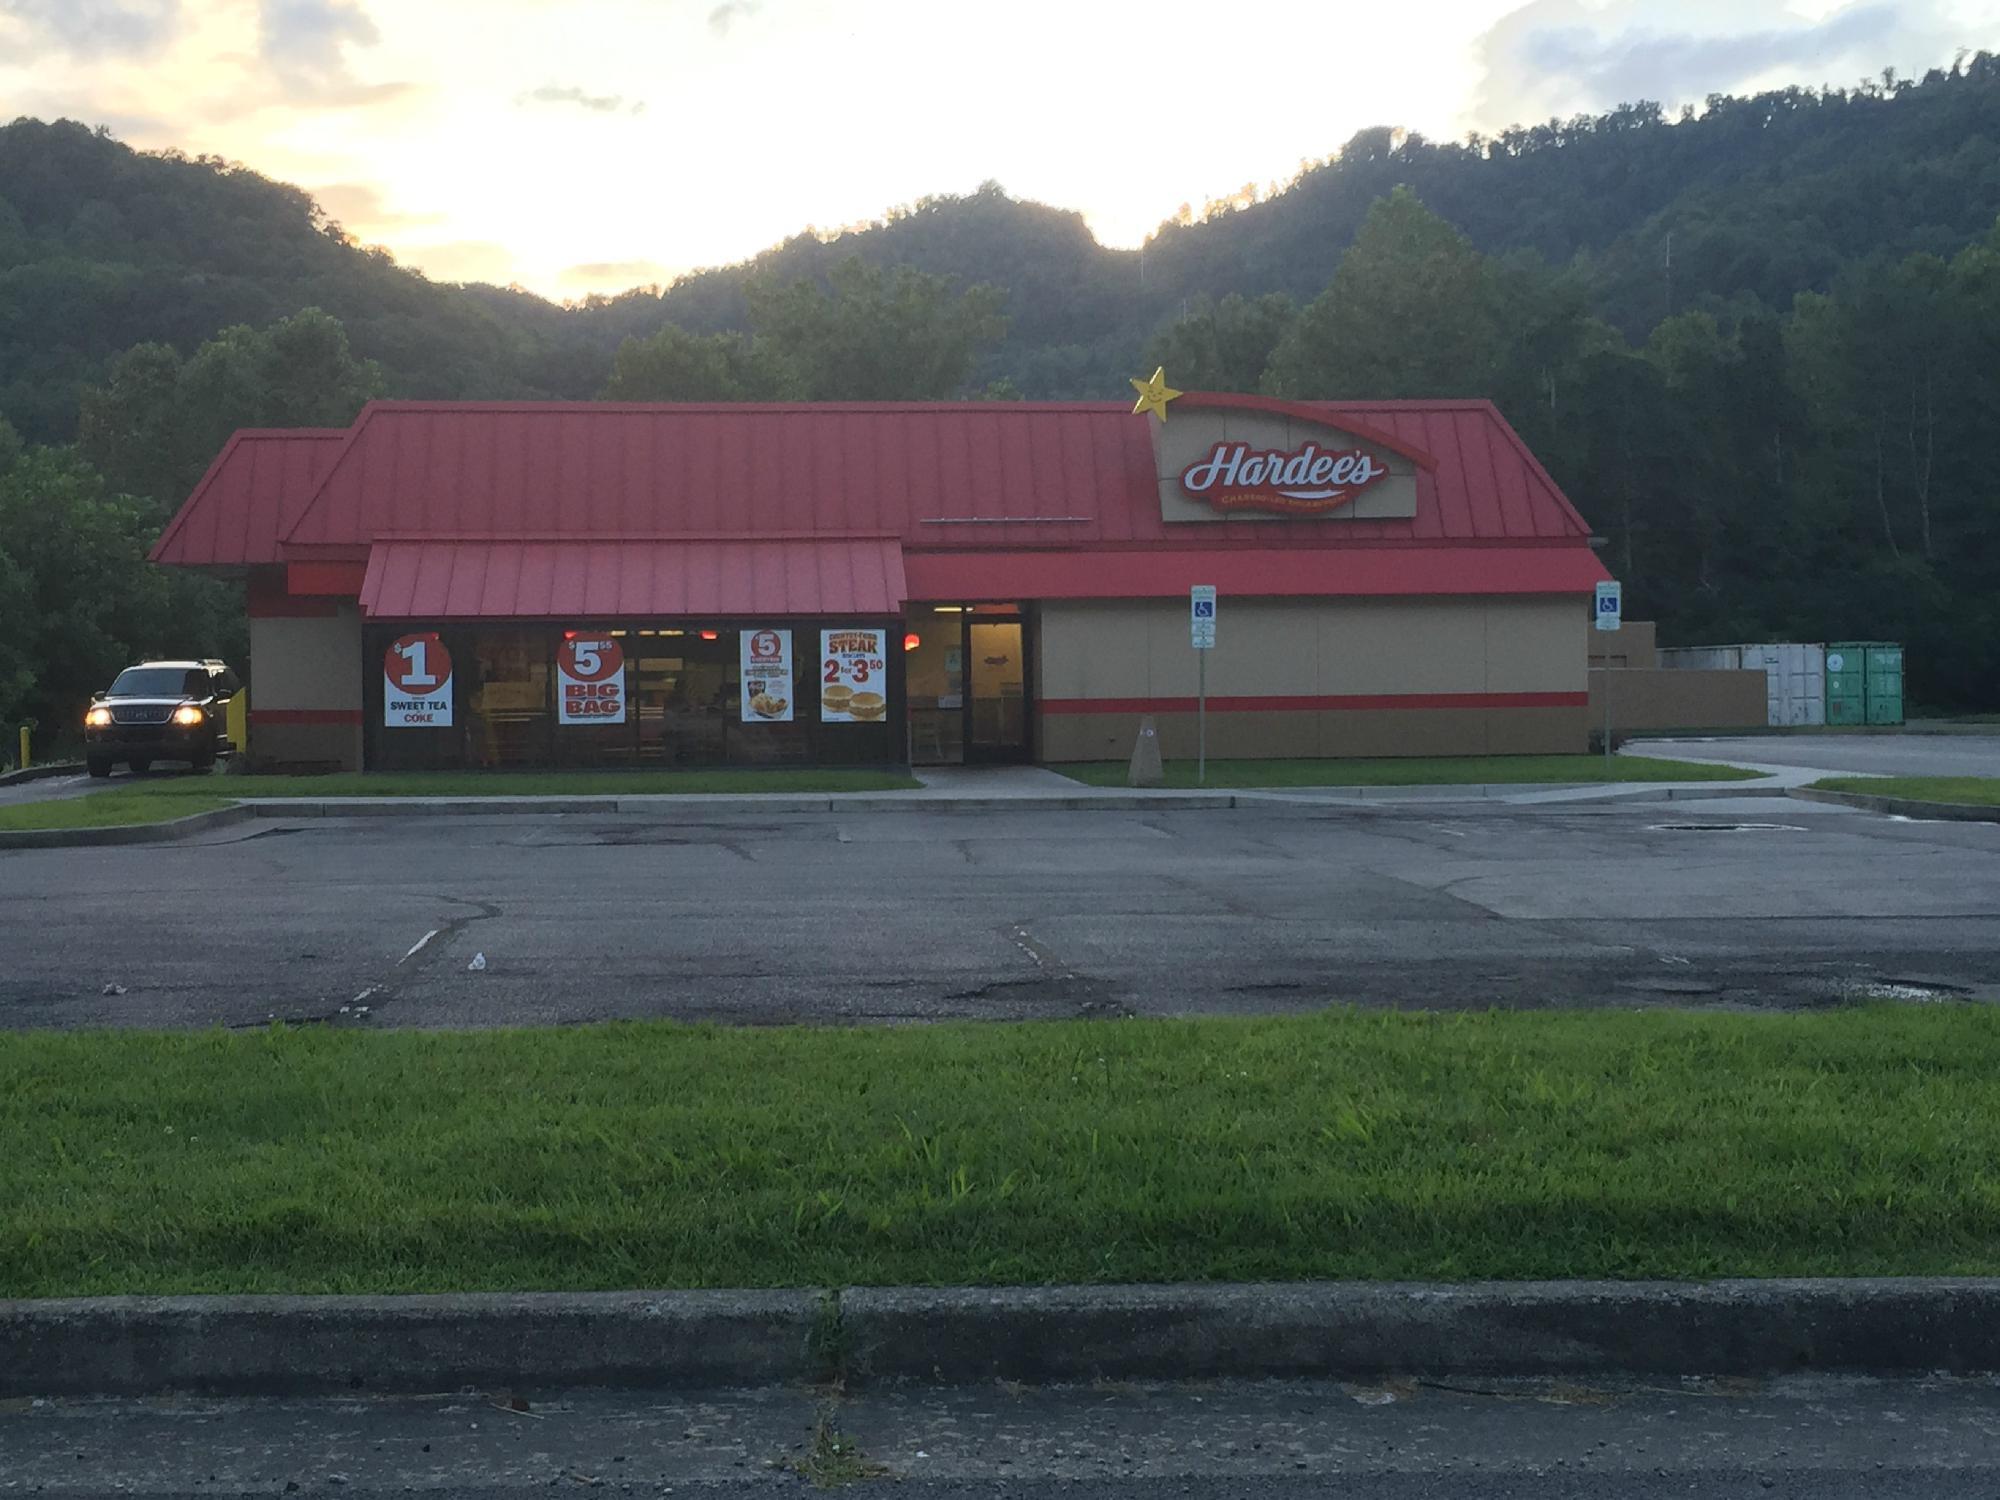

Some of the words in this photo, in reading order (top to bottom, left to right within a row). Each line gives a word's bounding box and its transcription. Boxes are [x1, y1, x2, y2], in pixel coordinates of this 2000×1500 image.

[1184, 445, 1385, 491] Hardee's
[829, 639, 876, 654] STEAK
[394, 641, 436, 685] $1
[824, 659, 840, 683] 2
[565, 684, 619, 698] BIG
[390, 701, 425, 710] SWEET
[427, 701, 447, 710] TEA
[565, 700, 620, 715] BAG
[404, 713, 433, 722] COKE
